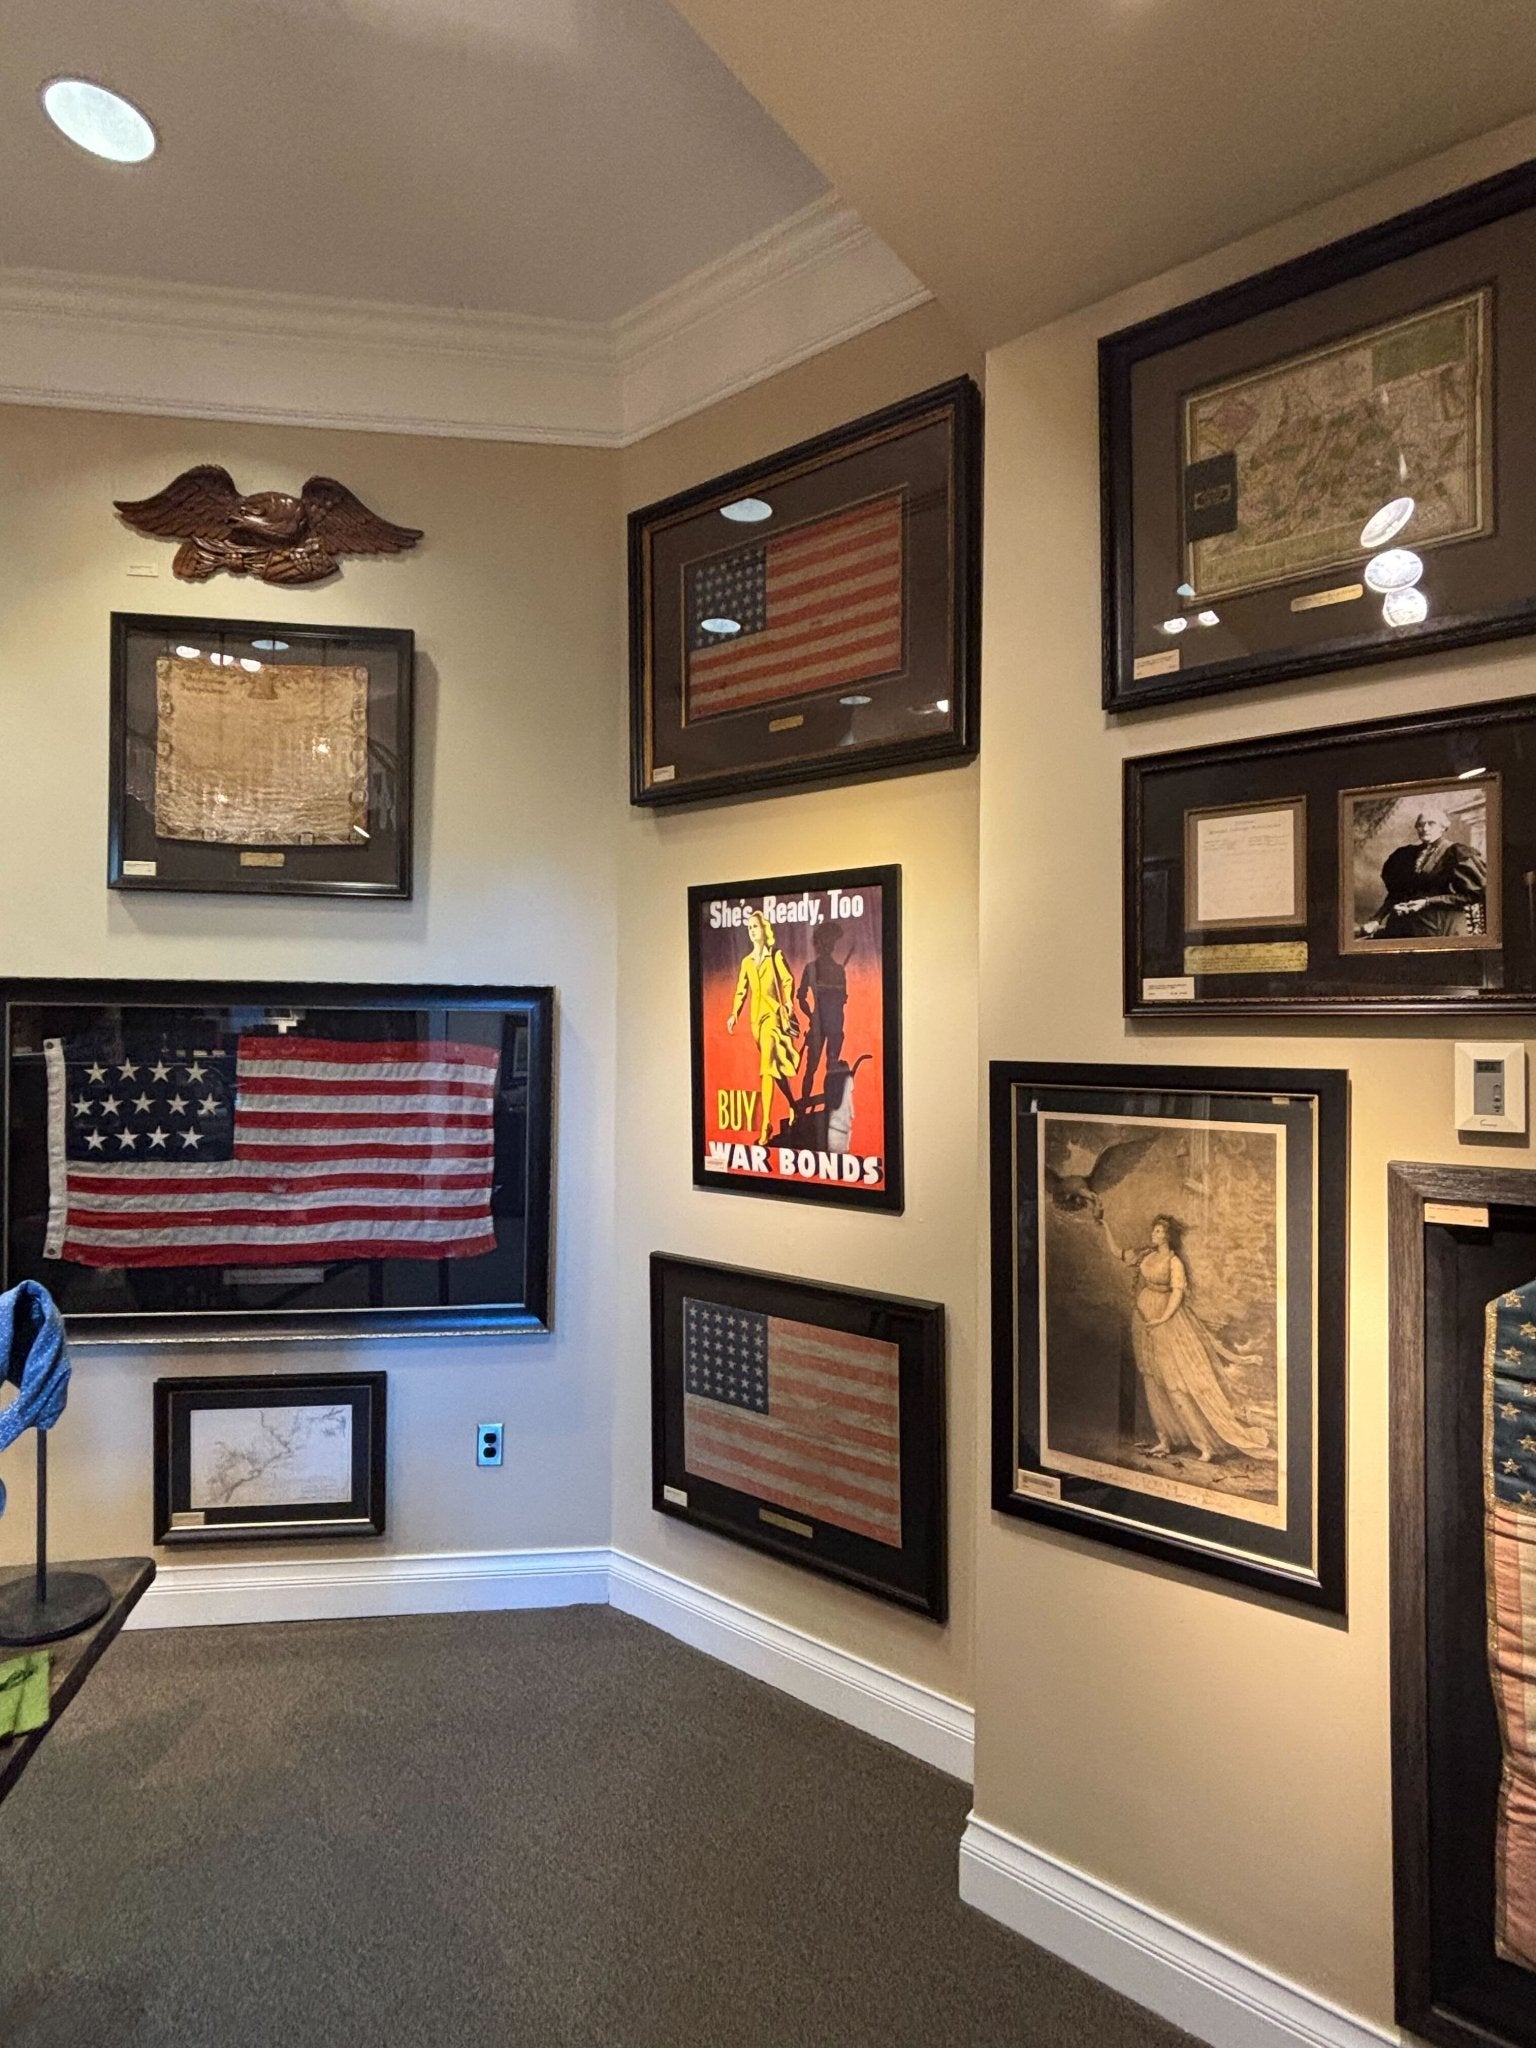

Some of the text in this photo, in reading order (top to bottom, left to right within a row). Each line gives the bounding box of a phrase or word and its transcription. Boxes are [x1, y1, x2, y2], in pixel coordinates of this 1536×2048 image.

[709, 889, 864, 929] She's Ready, Too
[717, 1089, 757, 1132] BUY
[708, 1141, 881, 1185] WAR BONDS
